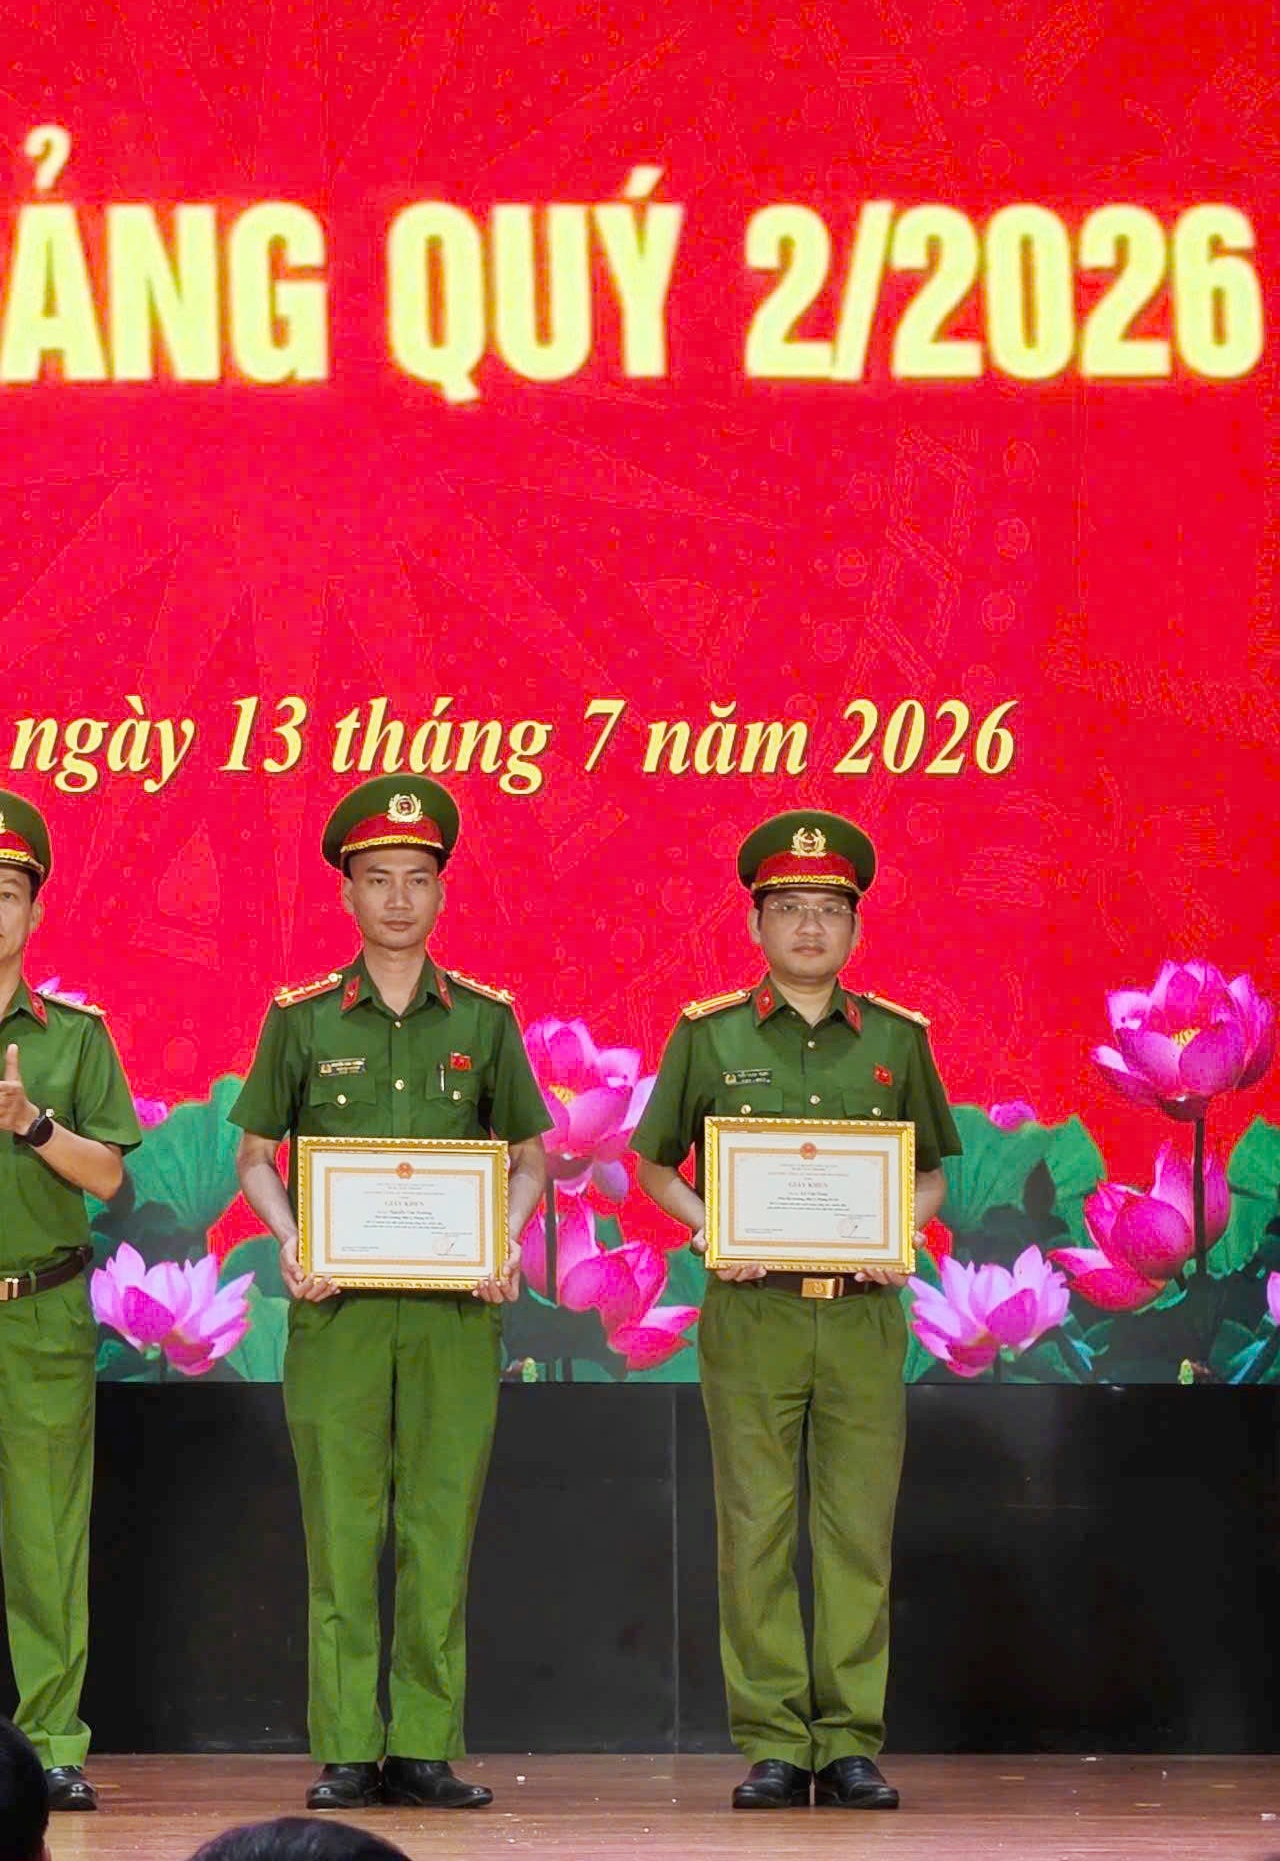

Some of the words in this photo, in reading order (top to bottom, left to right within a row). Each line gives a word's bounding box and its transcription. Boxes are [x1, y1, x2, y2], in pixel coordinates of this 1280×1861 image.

[388, 167, 682, 402] QUÝ
[745, 201, 1263, 382] 2/2026
[9, 695, 195, 794] ngày
[223, 697, 306, 772] 13
[333, 698, 552, 796] tháng
[586, 700, 624, 770] 7
[644, 700, 807, 774] năm
[834, 700, 1017, 774] 2026
